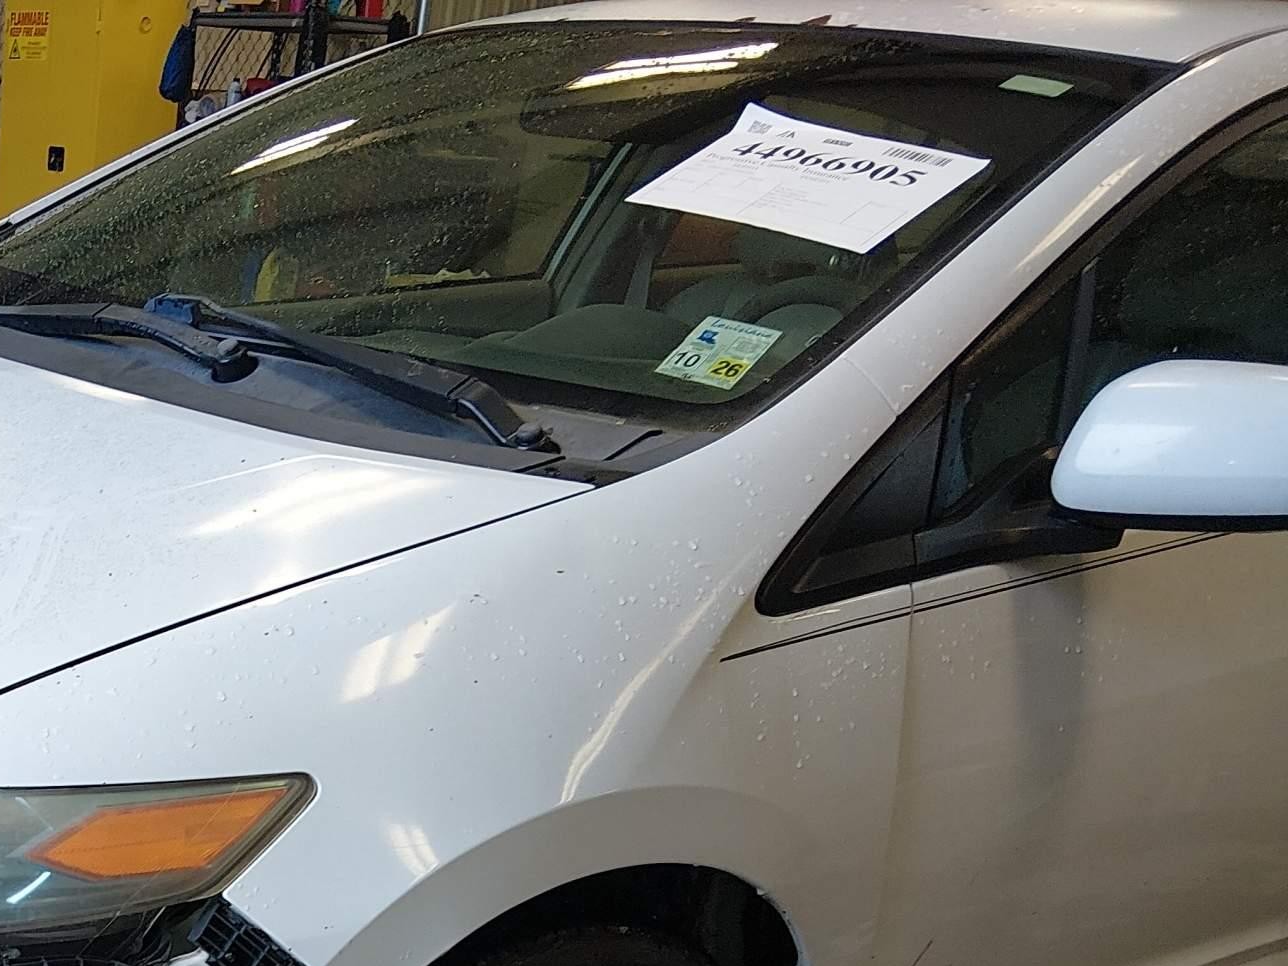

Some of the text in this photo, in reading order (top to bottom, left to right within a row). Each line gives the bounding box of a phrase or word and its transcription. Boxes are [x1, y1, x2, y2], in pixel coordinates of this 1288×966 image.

[10, 11, 50, 26] FLAMMABLE
[732, 141, 928, 187] 44966905
[674, 351, 702, 368] 10
[710, 360, 743, 378] 26
